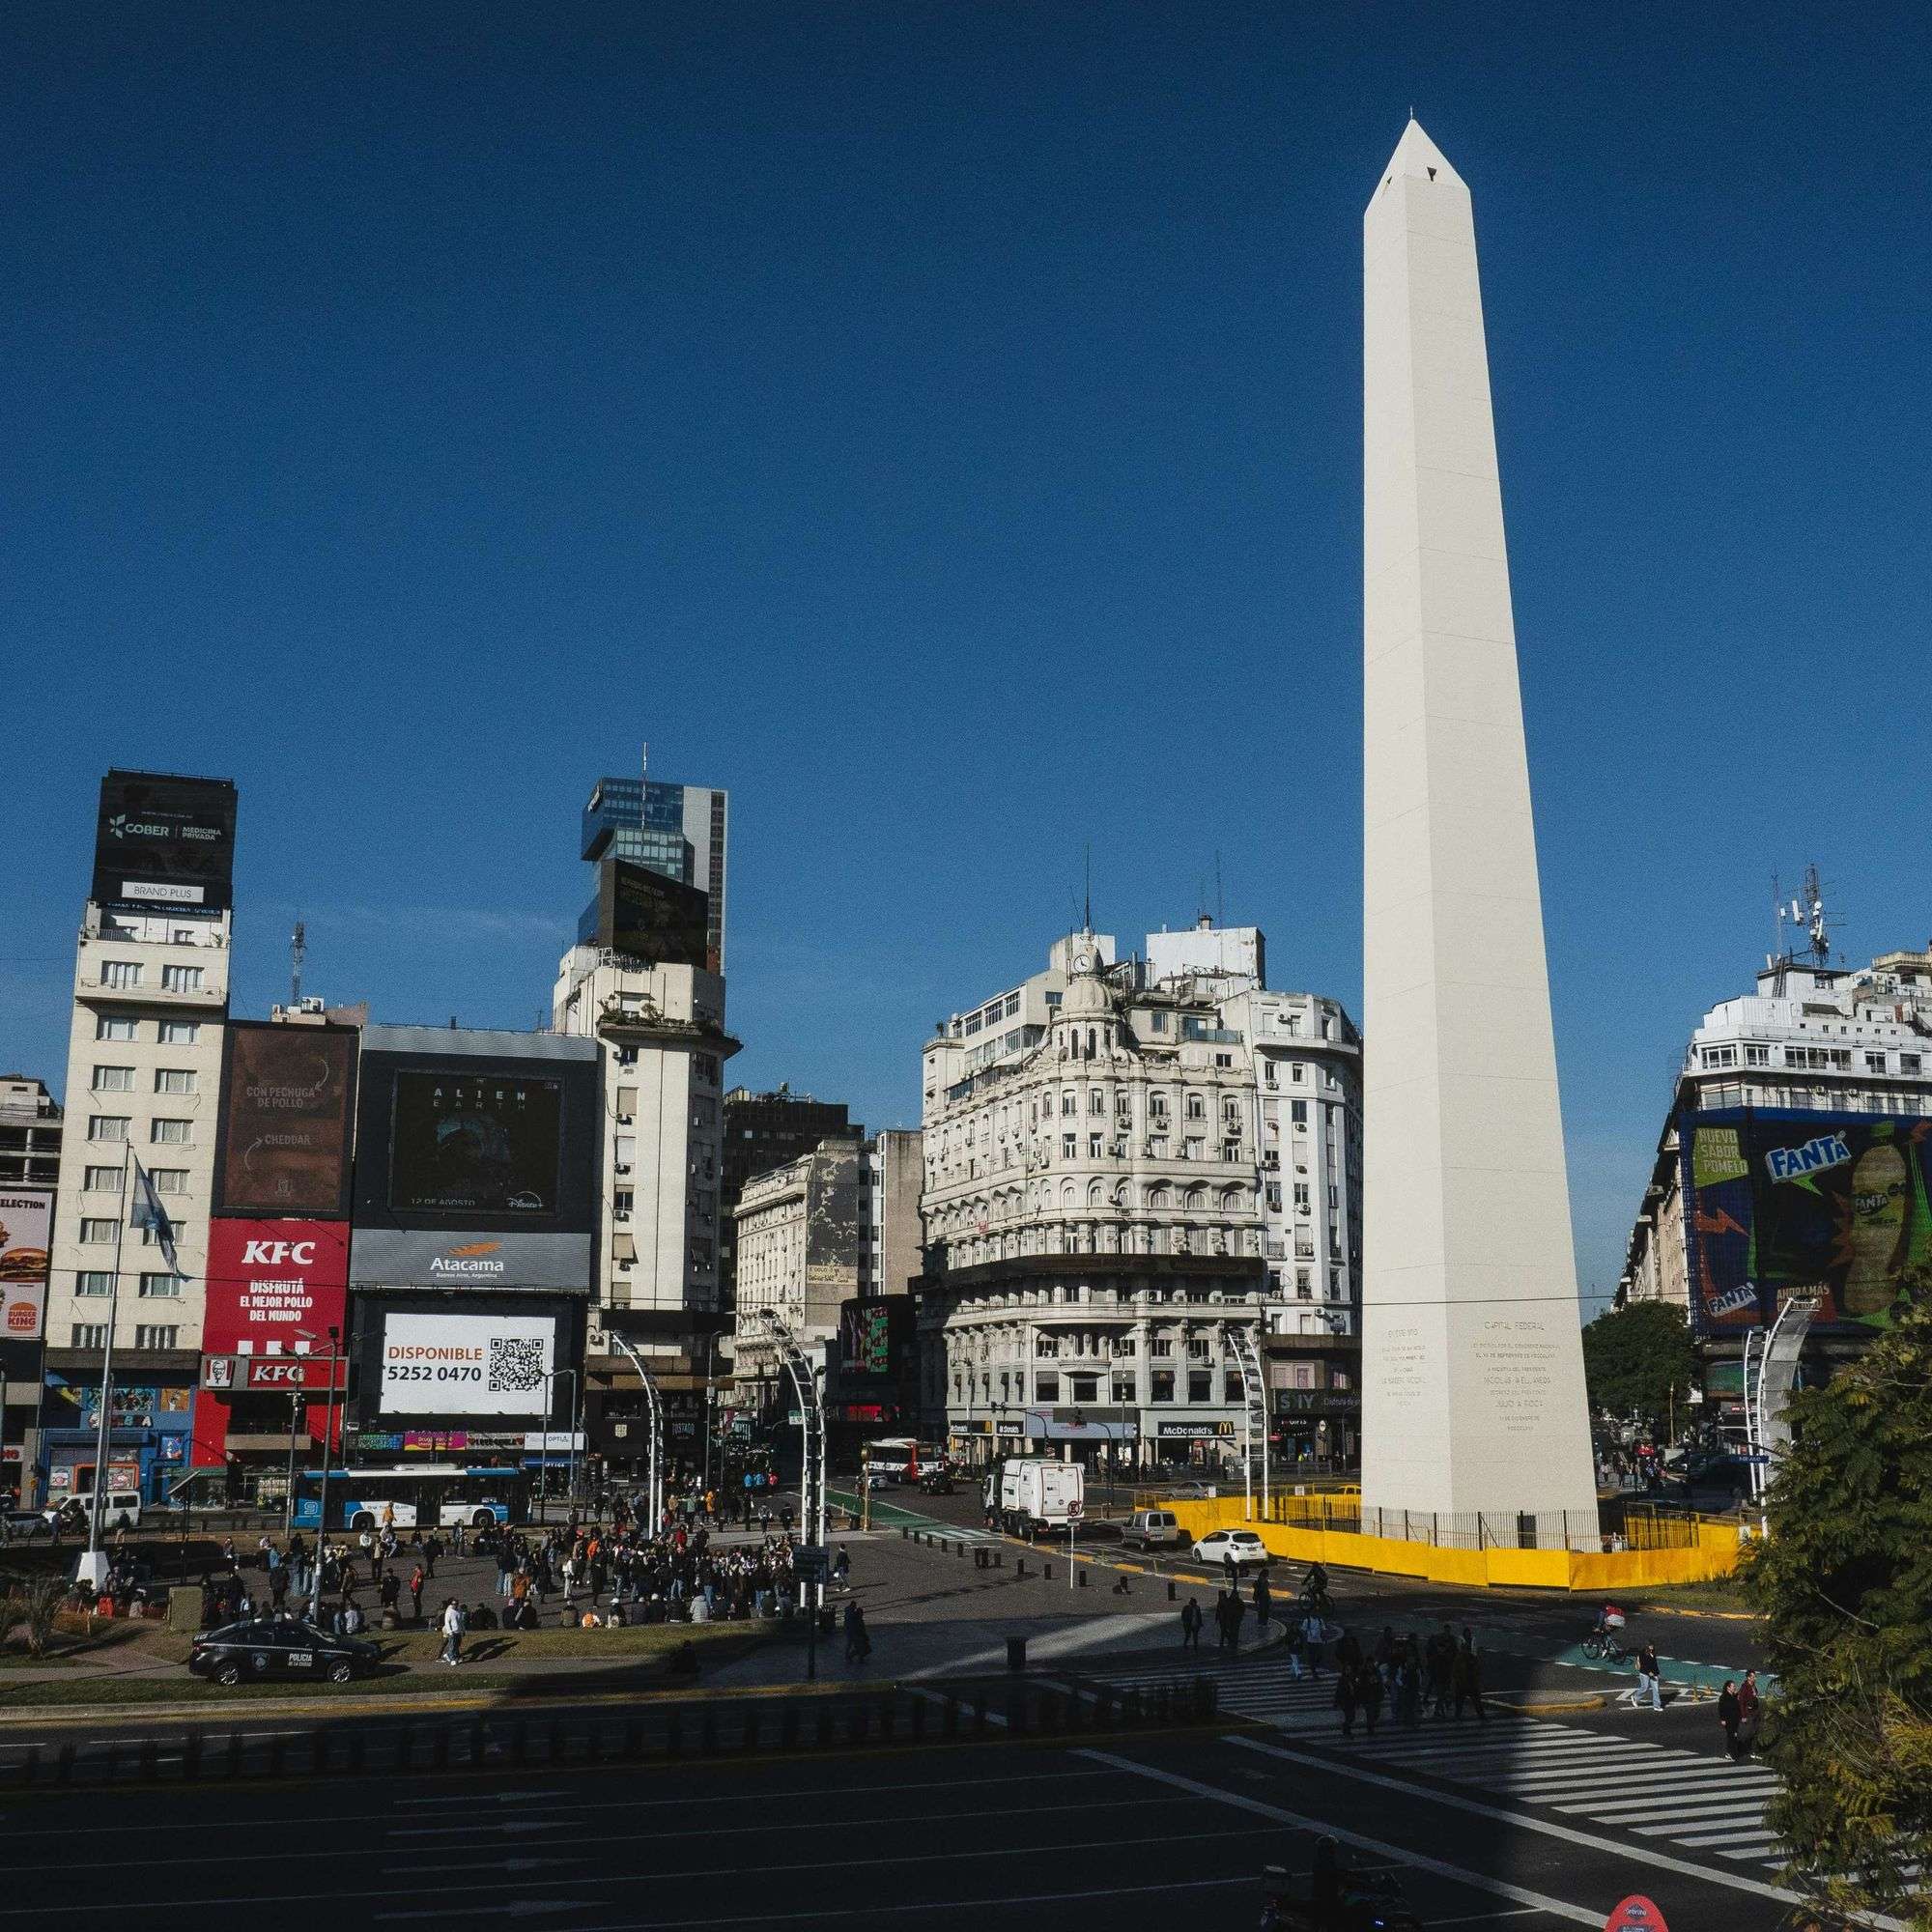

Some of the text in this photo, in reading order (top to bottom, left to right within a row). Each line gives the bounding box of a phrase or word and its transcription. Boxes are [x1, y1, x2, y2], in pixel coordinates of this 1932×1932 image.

[126, 823, 170, 838] COBER
[134, 886, 192, 898] BRAND PLUS
[272, 1097, 304, 1109] POLLO
[1699, 1144, 1740, 1158] SABOR
[1769, 1136, 1852, 1178] FANTA
[241, 1240, 316, 1264] KFC
[430, 1257, 504, 1271] Atacama
[249, 1277, 304, 1294] DISFRUTÁ
[240, 1295, 313, 1308] EL MEJOR POLLO
[1710, 1289, 1756, 1315] FANTA
[8, 1318, 36, 1326] KING
[249, 1310, 302, 1321] DEL MUNDO
[388, 1346, 483, 1361] DISPONIBLE
[251, 1365, 304, 1381] KFC
[388, 1366, 482, 1381] 5252 0470
[1162, 1426, 1213, 1435] McDonald's
